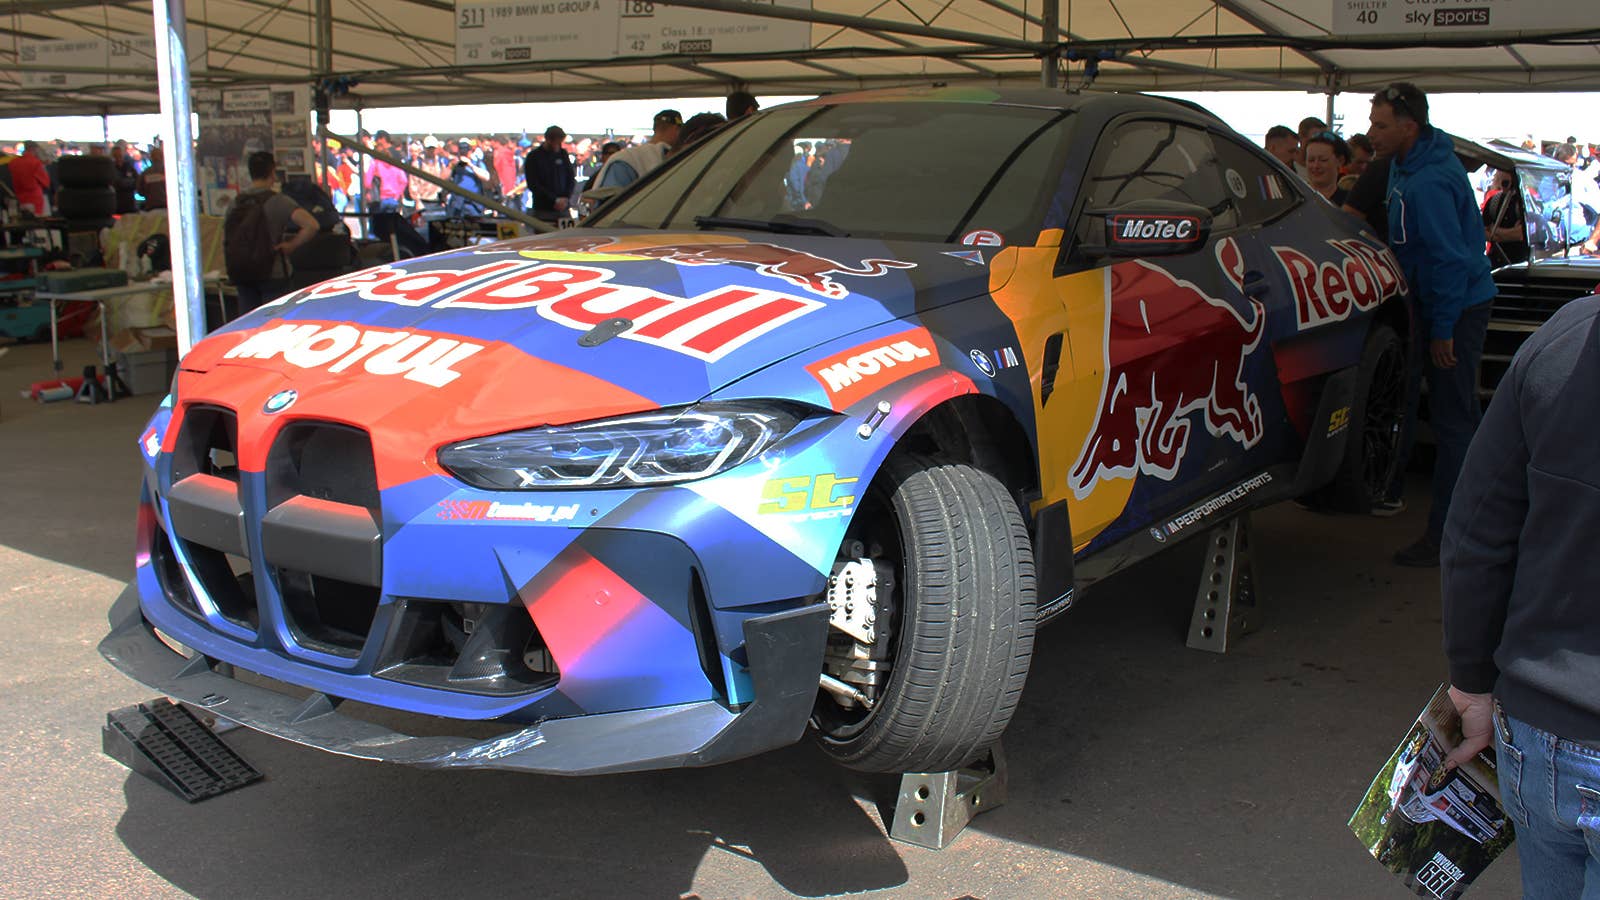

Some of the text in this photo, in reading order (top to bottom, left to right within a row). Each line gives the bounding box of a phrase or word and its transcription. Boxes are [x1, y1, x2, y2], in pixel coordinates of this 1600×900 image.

[461, 8, 484, 25] 511
[515, 5, 538, 16] BMW
[558, 2, 591, 13] GROUP
[592, 1, 600, 11] A
[1356, 10, 1378, 24] 40
[1405, 9, 1488, 26] sky sports
[631, 41, 645, 51] 42
[661, 40, 711, 52] sky sports
[1122, 219, 1192, 239] MoTeC
[1270, 239, 1379, 331] Red
[290, 260, 827, 363] ed Bull
[224, 323, 486, 388] MOTUL
[817, 340, 931, 393] MOTUL
[1174, 485, 1247, 530] PERFORMANCE
[1241, 471, 1273, 493] PARTS
[1416, 860, 1457, 899] 199
[1432, 851, 1465, 881] PASTRANA
